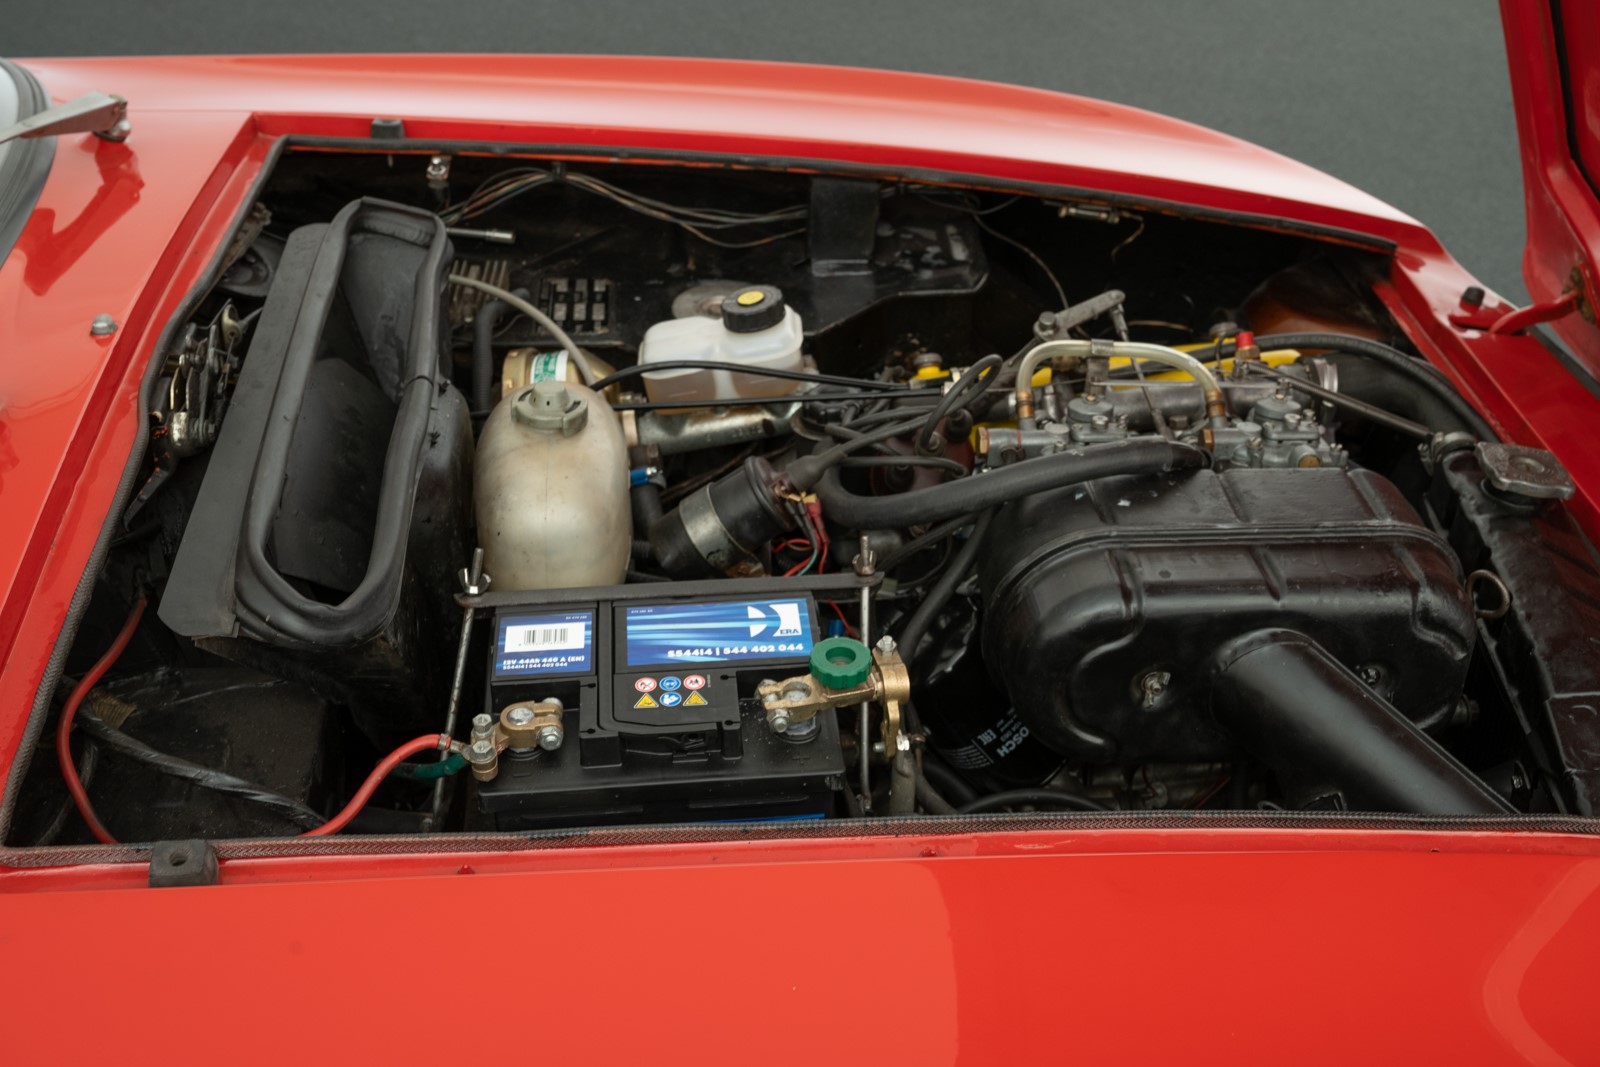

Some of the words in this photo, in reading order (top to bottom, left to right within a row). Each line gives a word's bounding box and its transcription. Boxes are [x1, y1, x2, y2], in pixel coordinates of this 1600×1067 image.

[723, 645, 748, 655] 544
[751, 644, 775, 653] 402
[778, 643, 804, 652] 044
[996, 726, 1030, 757] OSCH
